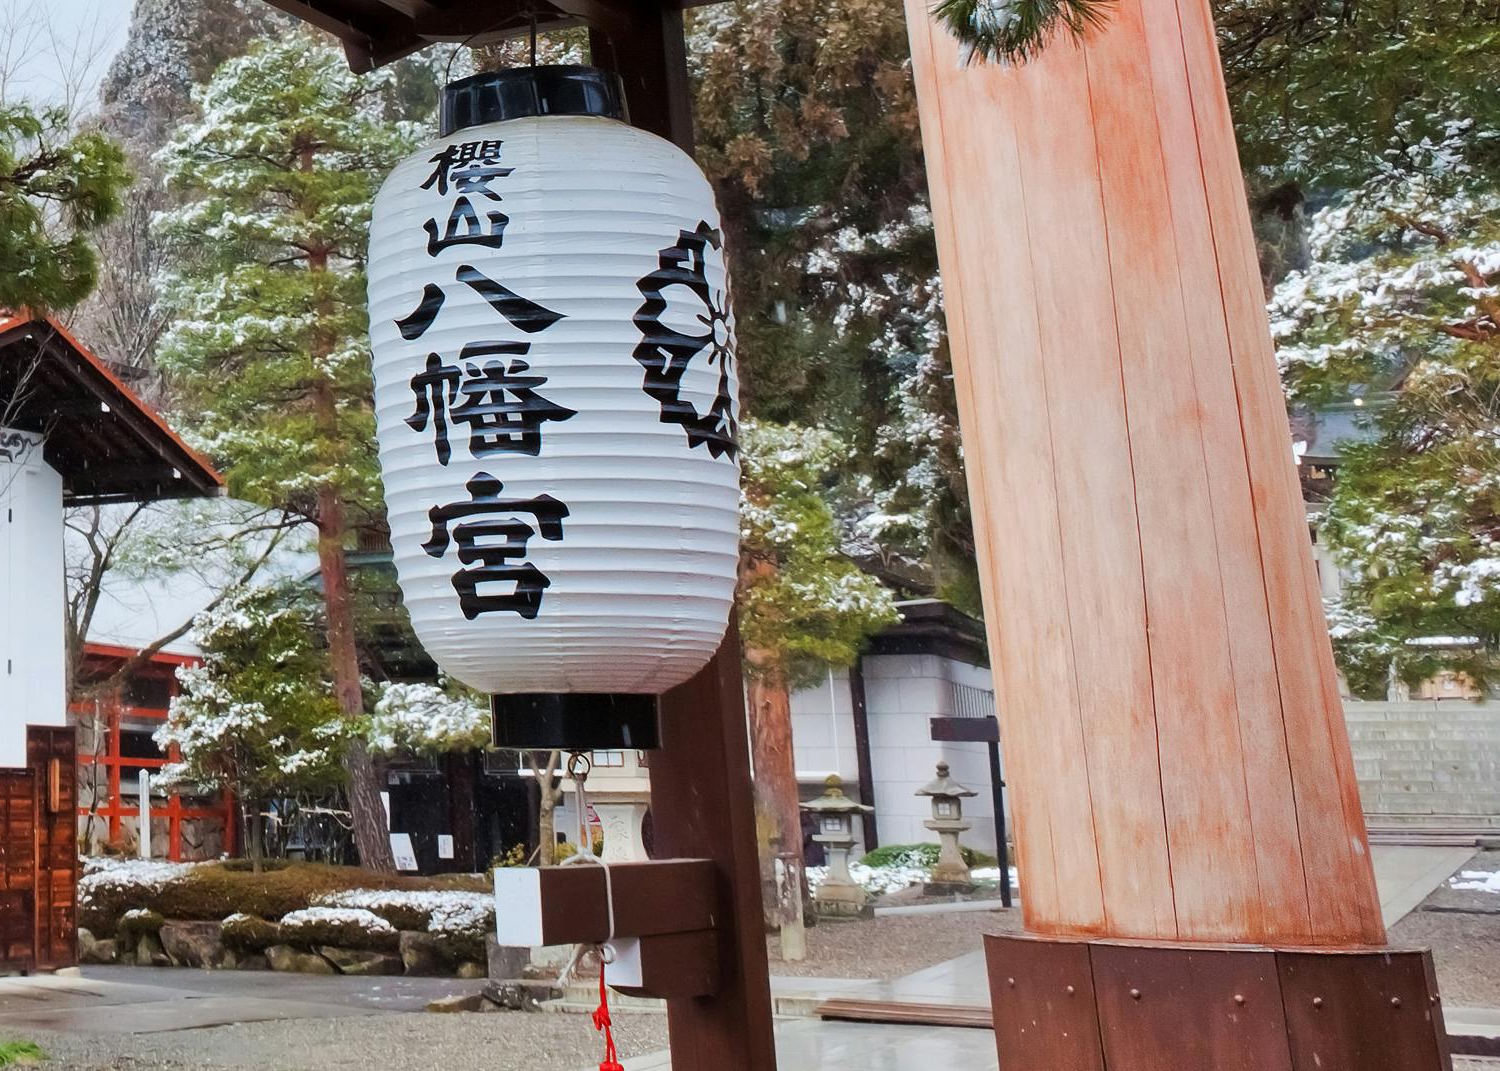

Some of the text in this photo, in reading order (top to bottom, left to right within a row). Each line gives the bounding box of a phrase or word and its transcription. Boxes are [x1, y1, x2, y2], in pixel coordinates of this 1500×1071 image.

[394, 139, 578, 620] 櫻山八幡宮
